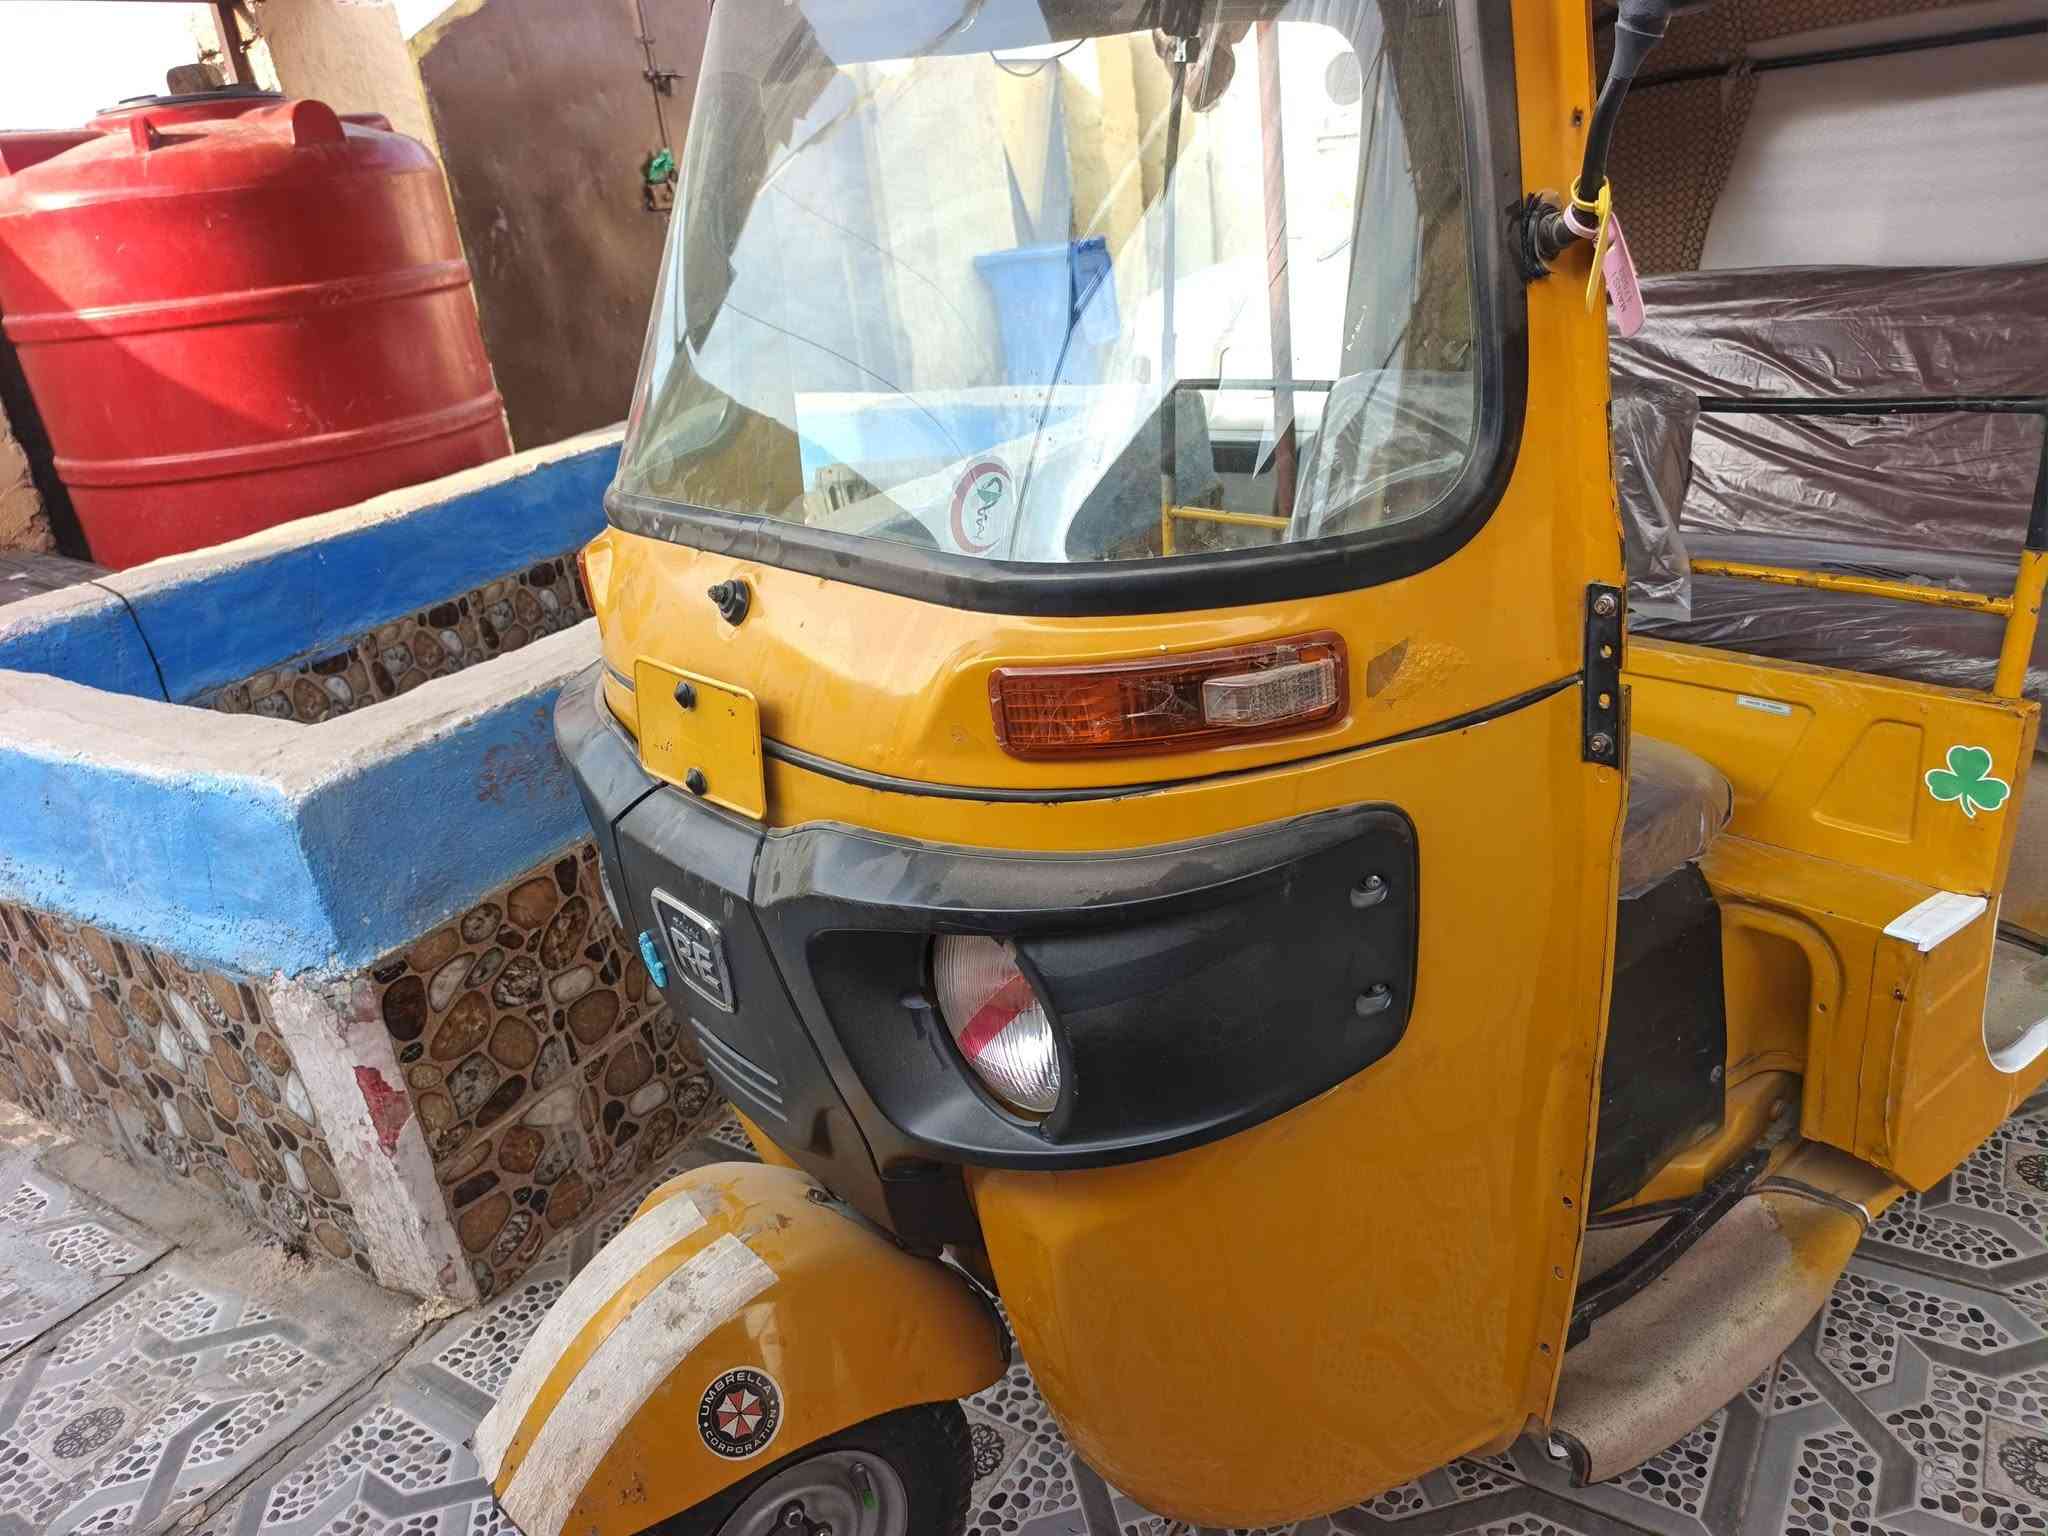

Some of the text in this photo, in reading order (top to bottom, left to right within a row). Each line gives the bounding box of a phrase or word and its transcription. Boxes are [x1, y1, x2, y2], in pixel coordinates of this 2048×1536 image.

[670, 927, 721, 990] RE
[701, 1372, 772, 1416] UMBRELLA
[705, 1409, 777, 1454] CORPORATION
